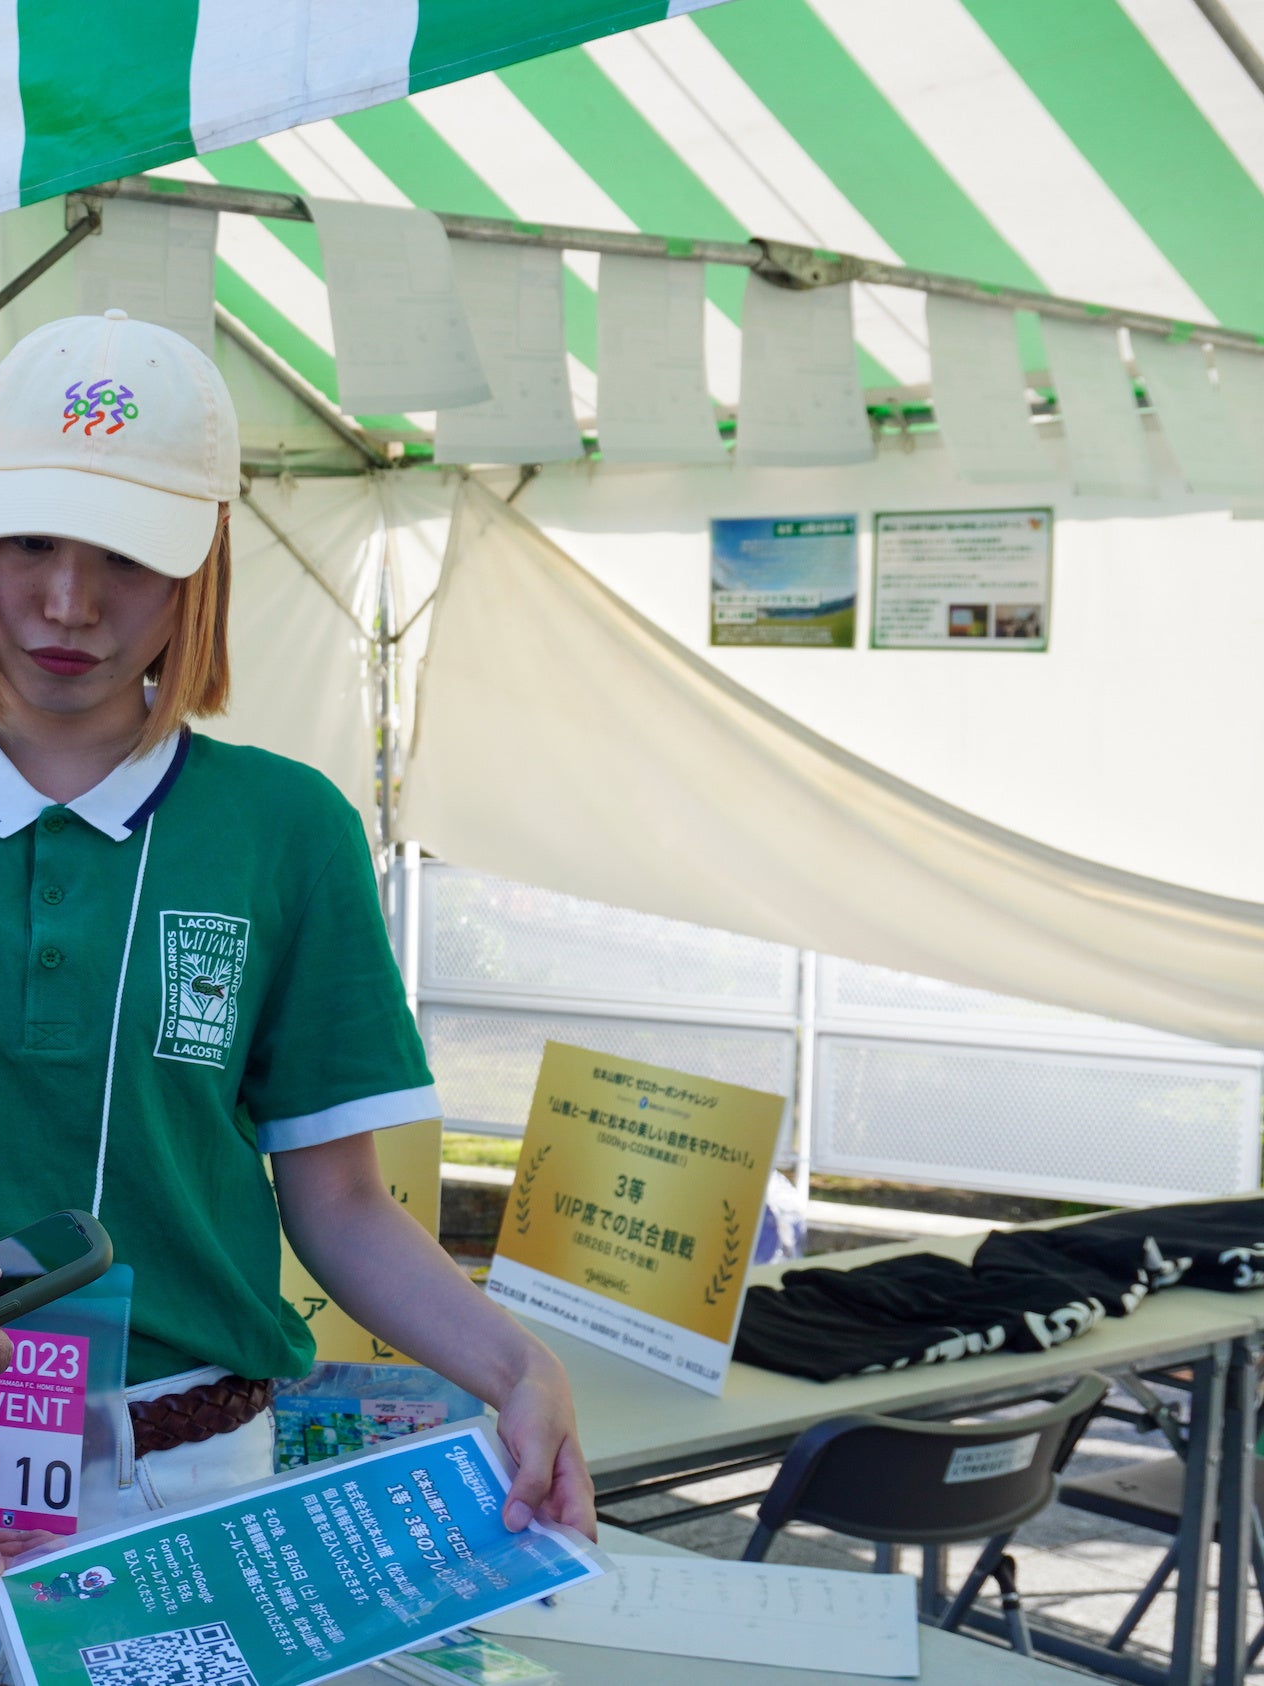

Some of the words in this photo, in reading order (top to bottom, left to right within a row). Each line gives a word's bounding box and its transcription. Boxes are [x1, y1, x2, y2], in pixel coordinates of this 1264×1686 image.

[178, 918, 238, 935] LACOSTE
[167, 931, 177, 978] GARROS
[231, 939, 245, 994] ROLAND
[165, 984, 179, 1038] ROLAND
[223, 995, 237, 1048] GARROS
[173, 1042, 223, 1060] LACOSTE
[614, 1175, 646, 1204] 3等
[554, 1192, 696, 1261] VIP席での試合観戦
[0, 1379, 24, 1388] YAMAGA
[5, 1339, 79, 1380] 023
[175, 1532, 214, 1604] QRコードのGoogle
[301, 1494, 369, 1606] 同意書を記入いただきます。
[123, 1549, 158, 1613] 記入してください。
[221, 1520, 298, 1656] メールでご連絡させていただきます。
